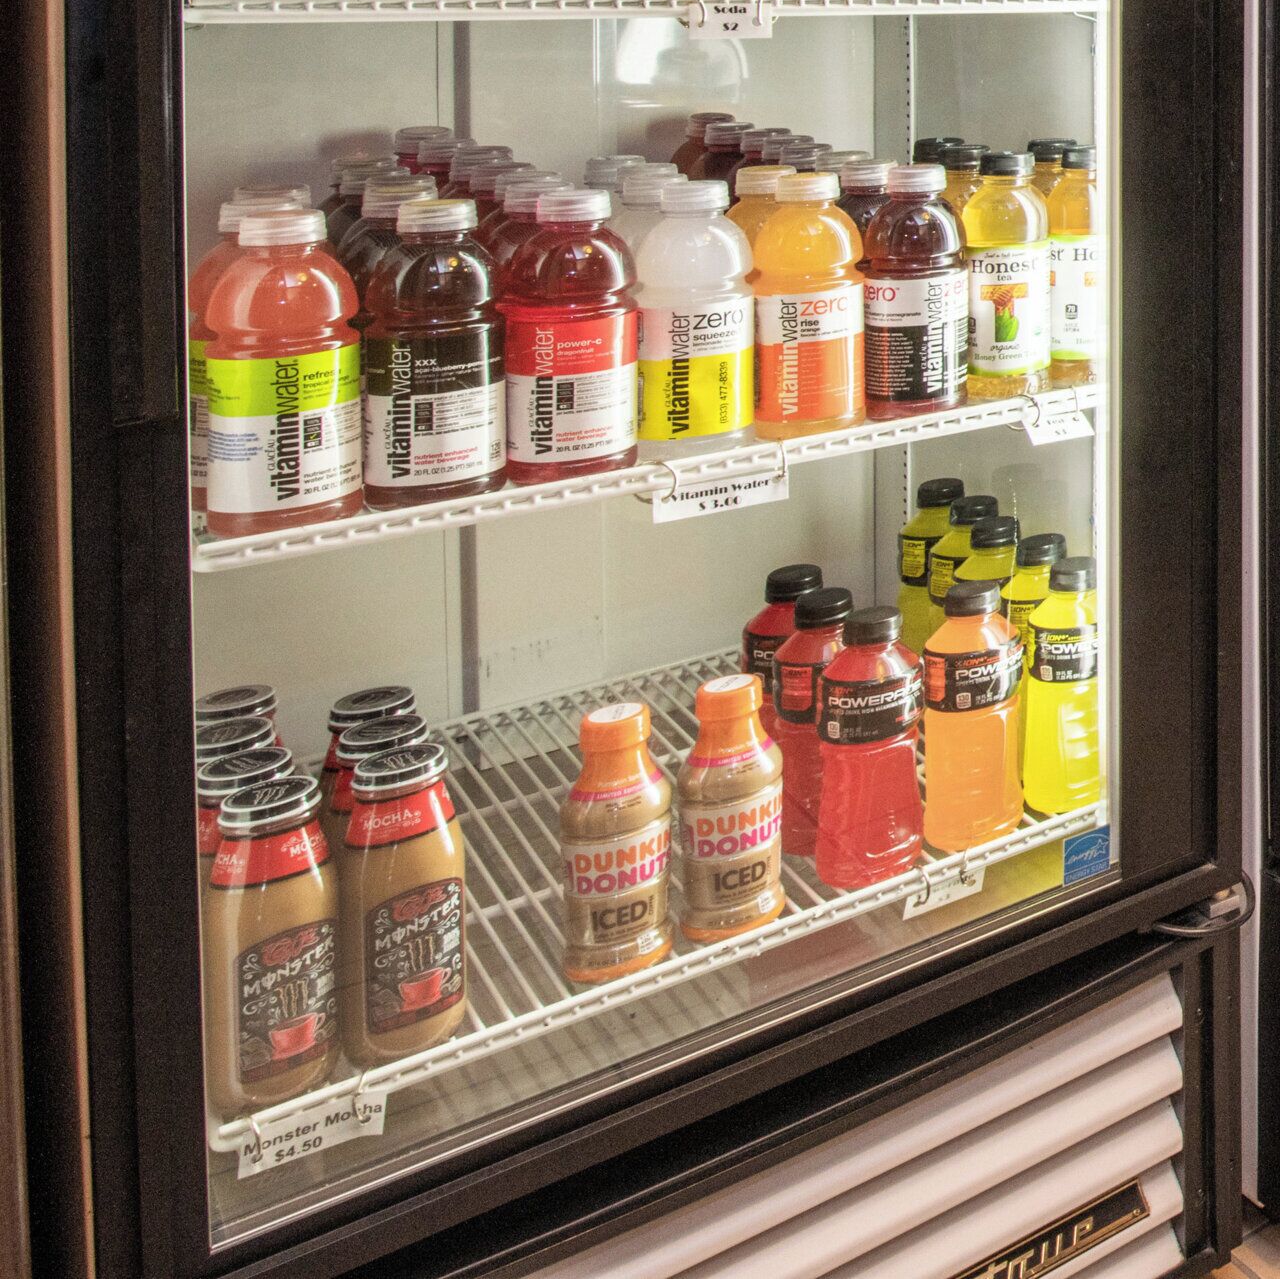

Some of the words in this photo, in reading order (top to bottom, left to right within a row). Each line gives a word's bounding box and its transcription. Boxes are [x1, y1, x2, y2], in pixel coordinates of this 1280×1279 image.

[714, 5, 747, 14] Soda
[723, 23, 739, 31] $2
[971, 256, 1038, 274] Honest
[997, 273, 1012, 281] tea
[693, 310, 743, 331] zero
[801, 318, 819, 327] rise
[556, 338, 603, 350] power-c
[671, 486, 728, 503] Vitamin
[730, 478, 770, 494] Water
[699, 501, 707, 511] $
[713, 494, 742, 509] 3.00
[362, 808, 413, 830] MOCHA
[713, 860, 767, 892] ICED
[591, 900, 648, 932] ICED
[243, 1120, 320, 1159] Monster
[273, 1137, 323, 1163] $4.50
